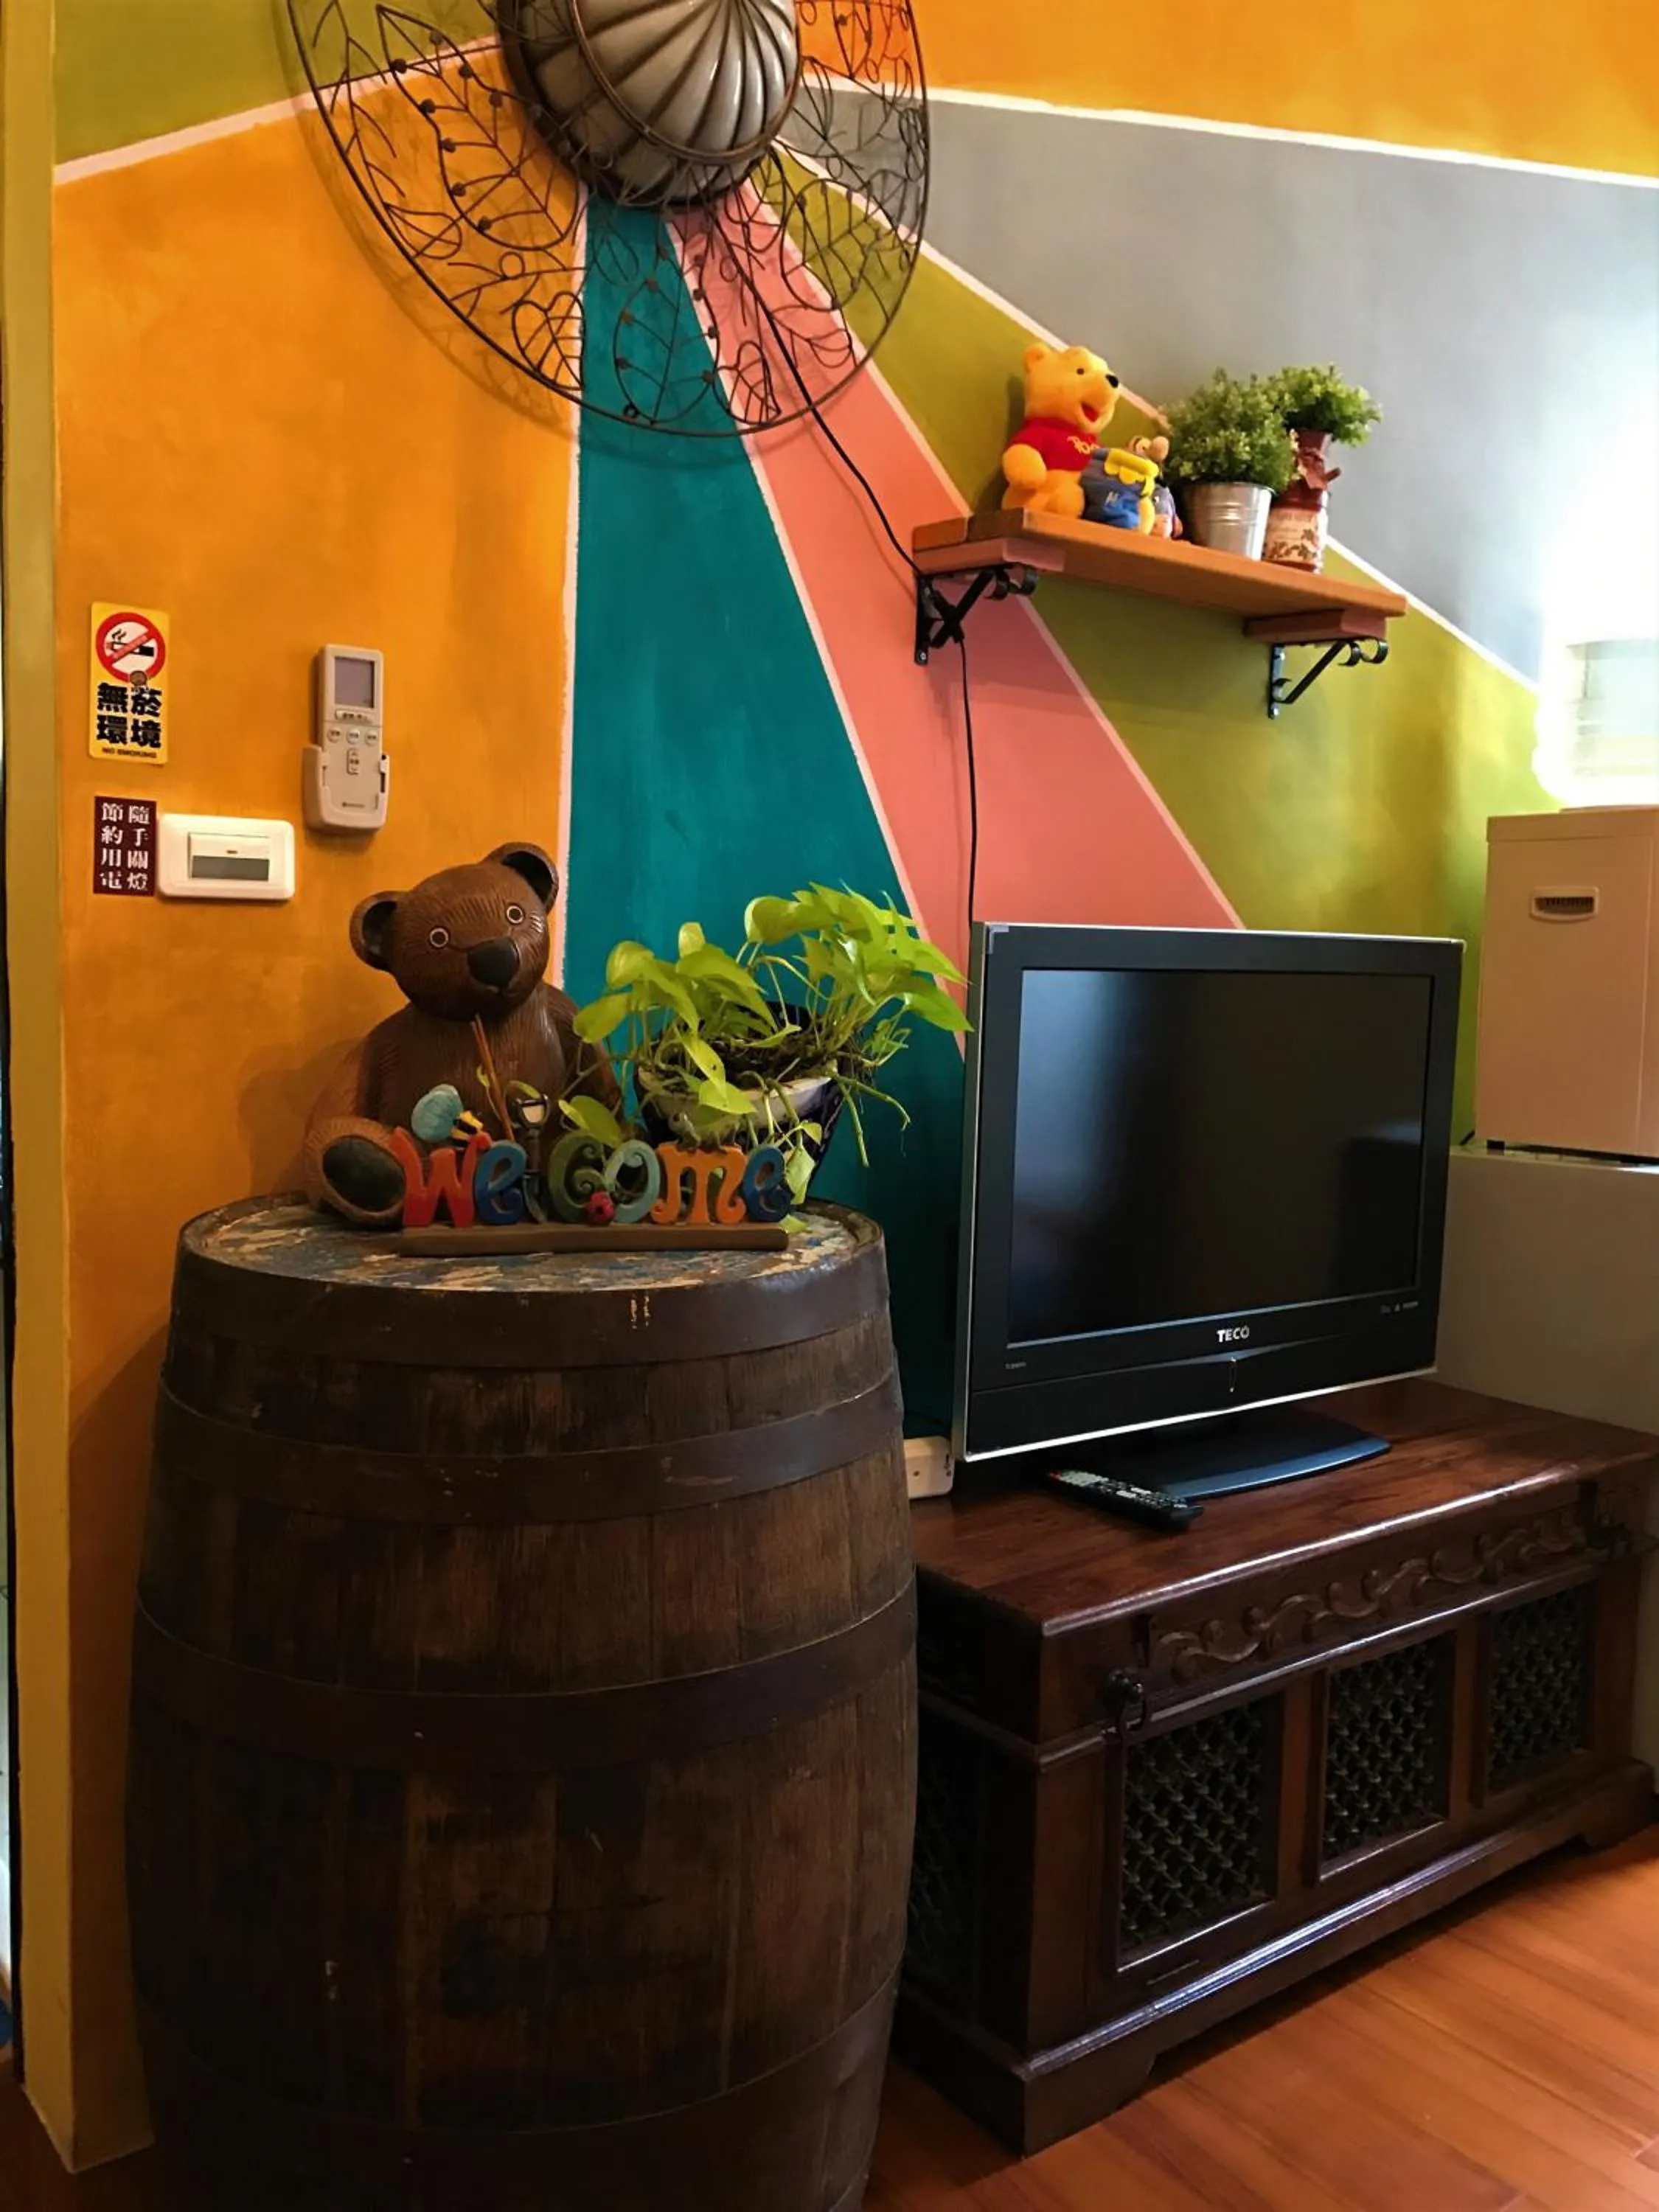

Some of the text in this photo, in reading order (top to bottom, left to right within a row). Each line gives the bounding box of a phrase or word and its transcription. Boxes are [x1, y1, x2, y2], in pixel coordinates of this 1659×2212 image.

[97, 682, 162, 717] 無菸
[97, 714, 161, 748] 環境
[100, 802, 123, 890] 節約用電
[127, 804, 150, 891] 隨手關燈
[1216, 1325, 1251, 1343] TECO
